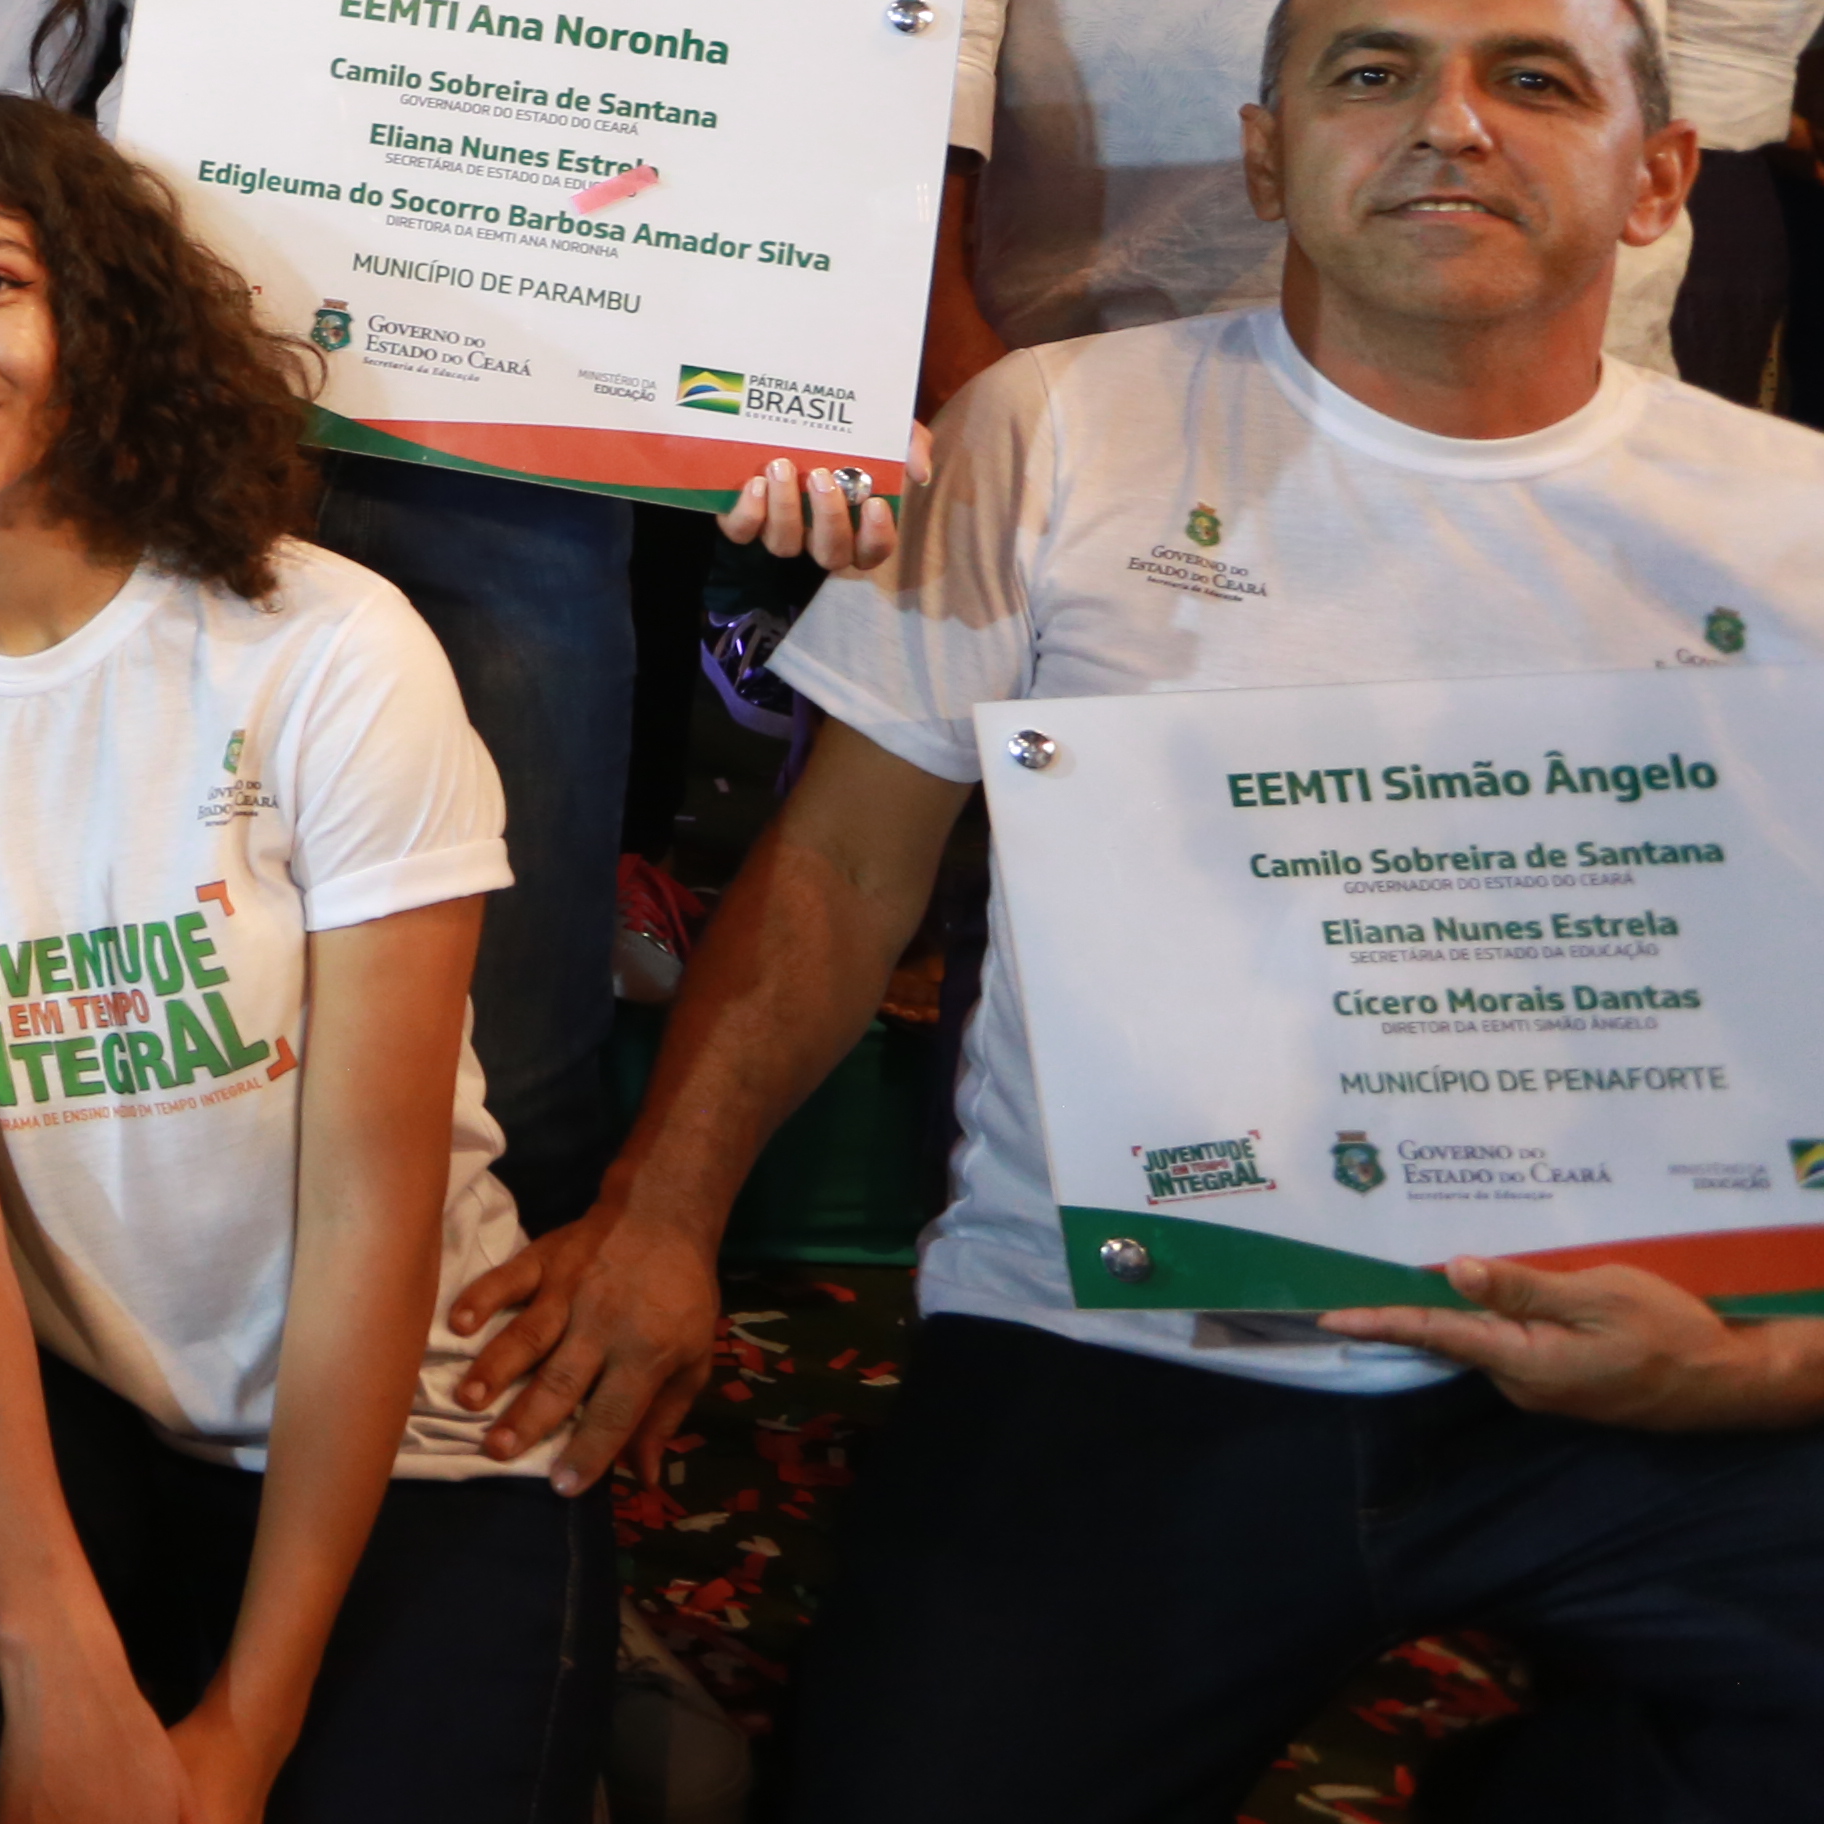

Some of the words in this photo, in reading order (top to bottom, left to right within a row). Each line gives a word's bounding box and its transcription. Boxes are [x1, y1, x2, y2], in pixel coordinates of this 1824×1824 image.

[467, 5, 543, 41] Ana
[555, 14, 729, 65] Noronha
[198, 160, 341, 200] Edigleuma
[349, 182, 383, 206] do
[390, 188, 500, 223] Socorro
[508, 204, 625, 242] Barbosa
[632, 223, 752, 259] Amador
[758, 241, 830, 271] Silva
[353, 253, 474, 288] MUNICÍPIO
[480, 272, 513, 294] DE
[519, 278, 641, 314] PARAMBU
[1227, 768, 1372, 808] EEMTI
[1382, 761, 1531, 801] Simão
[1545, 750, 1719, 803] Ângelo
[8, 1001, 63, 1038] EM
[68, 990, 150, 1030] TEMPO
[1333, 990, 1438, 1016] Cícero
[1446, 986, 1565, 1014] Morais
[1572, 985, 1701, 1011] Dantas
[1340, 1065, 1490, 1094] MUNICÍPIO
[1497, 1069, 1538, 1092] DE
[1544, 1067, 1726, 1092] PENAFORTE
